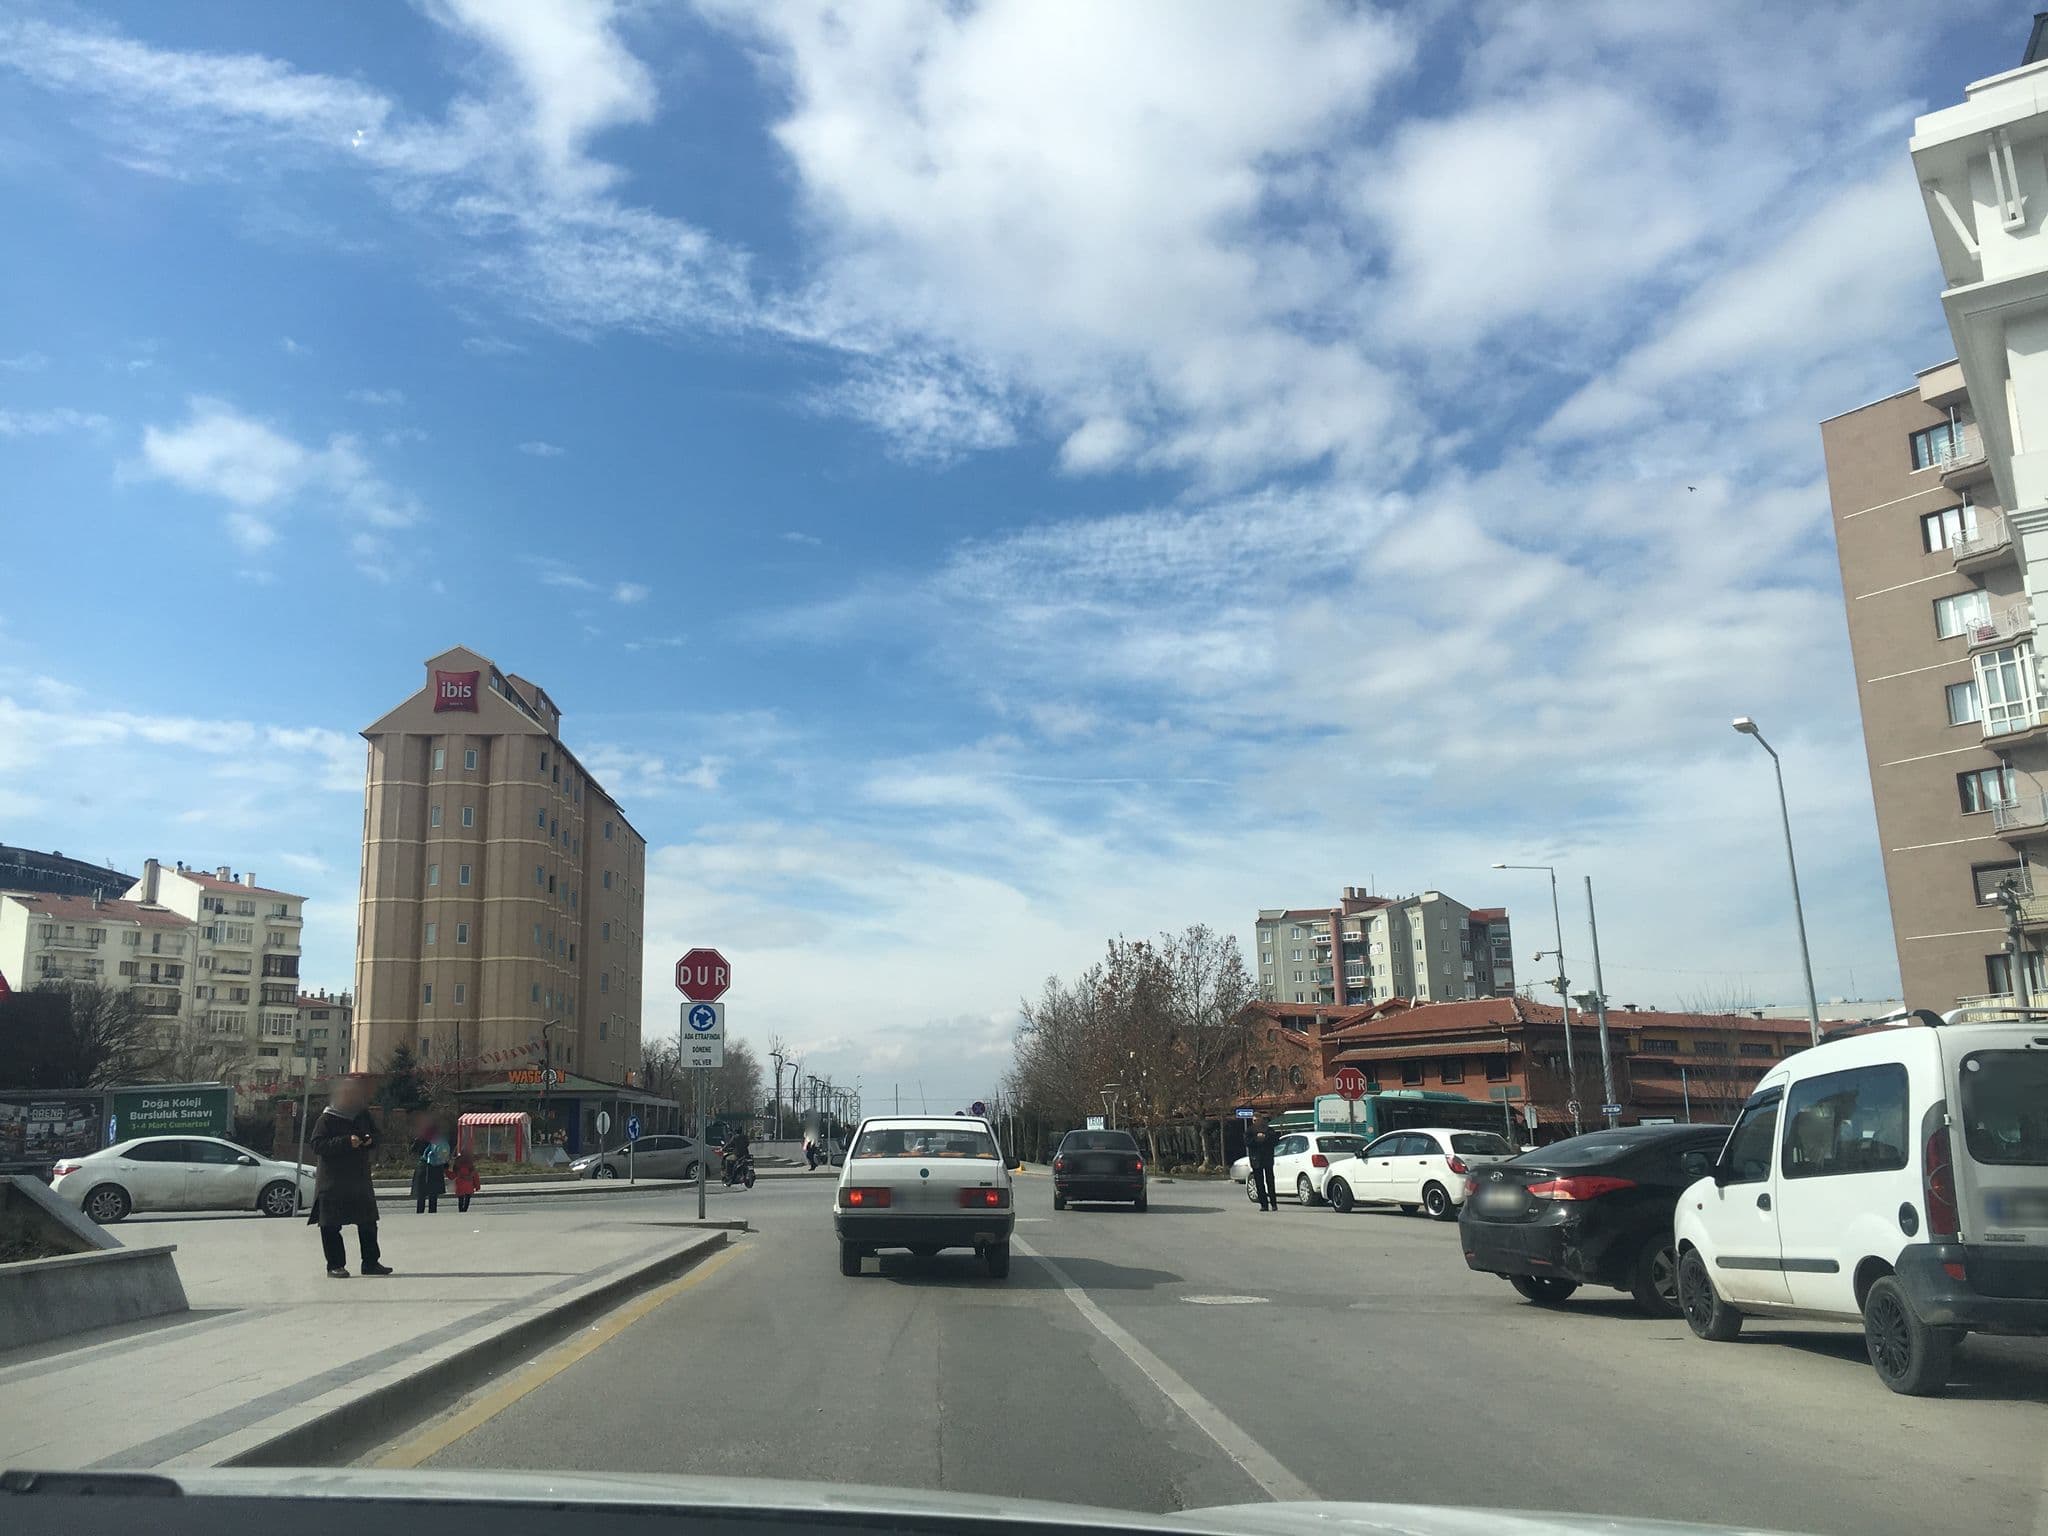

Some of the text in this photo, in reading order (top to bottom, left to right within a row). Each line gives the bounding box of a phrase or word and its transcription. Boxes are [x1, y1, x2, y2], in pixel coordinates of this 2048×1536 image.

[441, 681, 472, 698] ibis
[680, 965, 726, 986] DUR
[1335, 1077, 1365, 1091] DUR
[142, 1097, 202, 1110] Doğa Koleji
[129, 1110, 213, 1120] Bursluluk Sınavı
